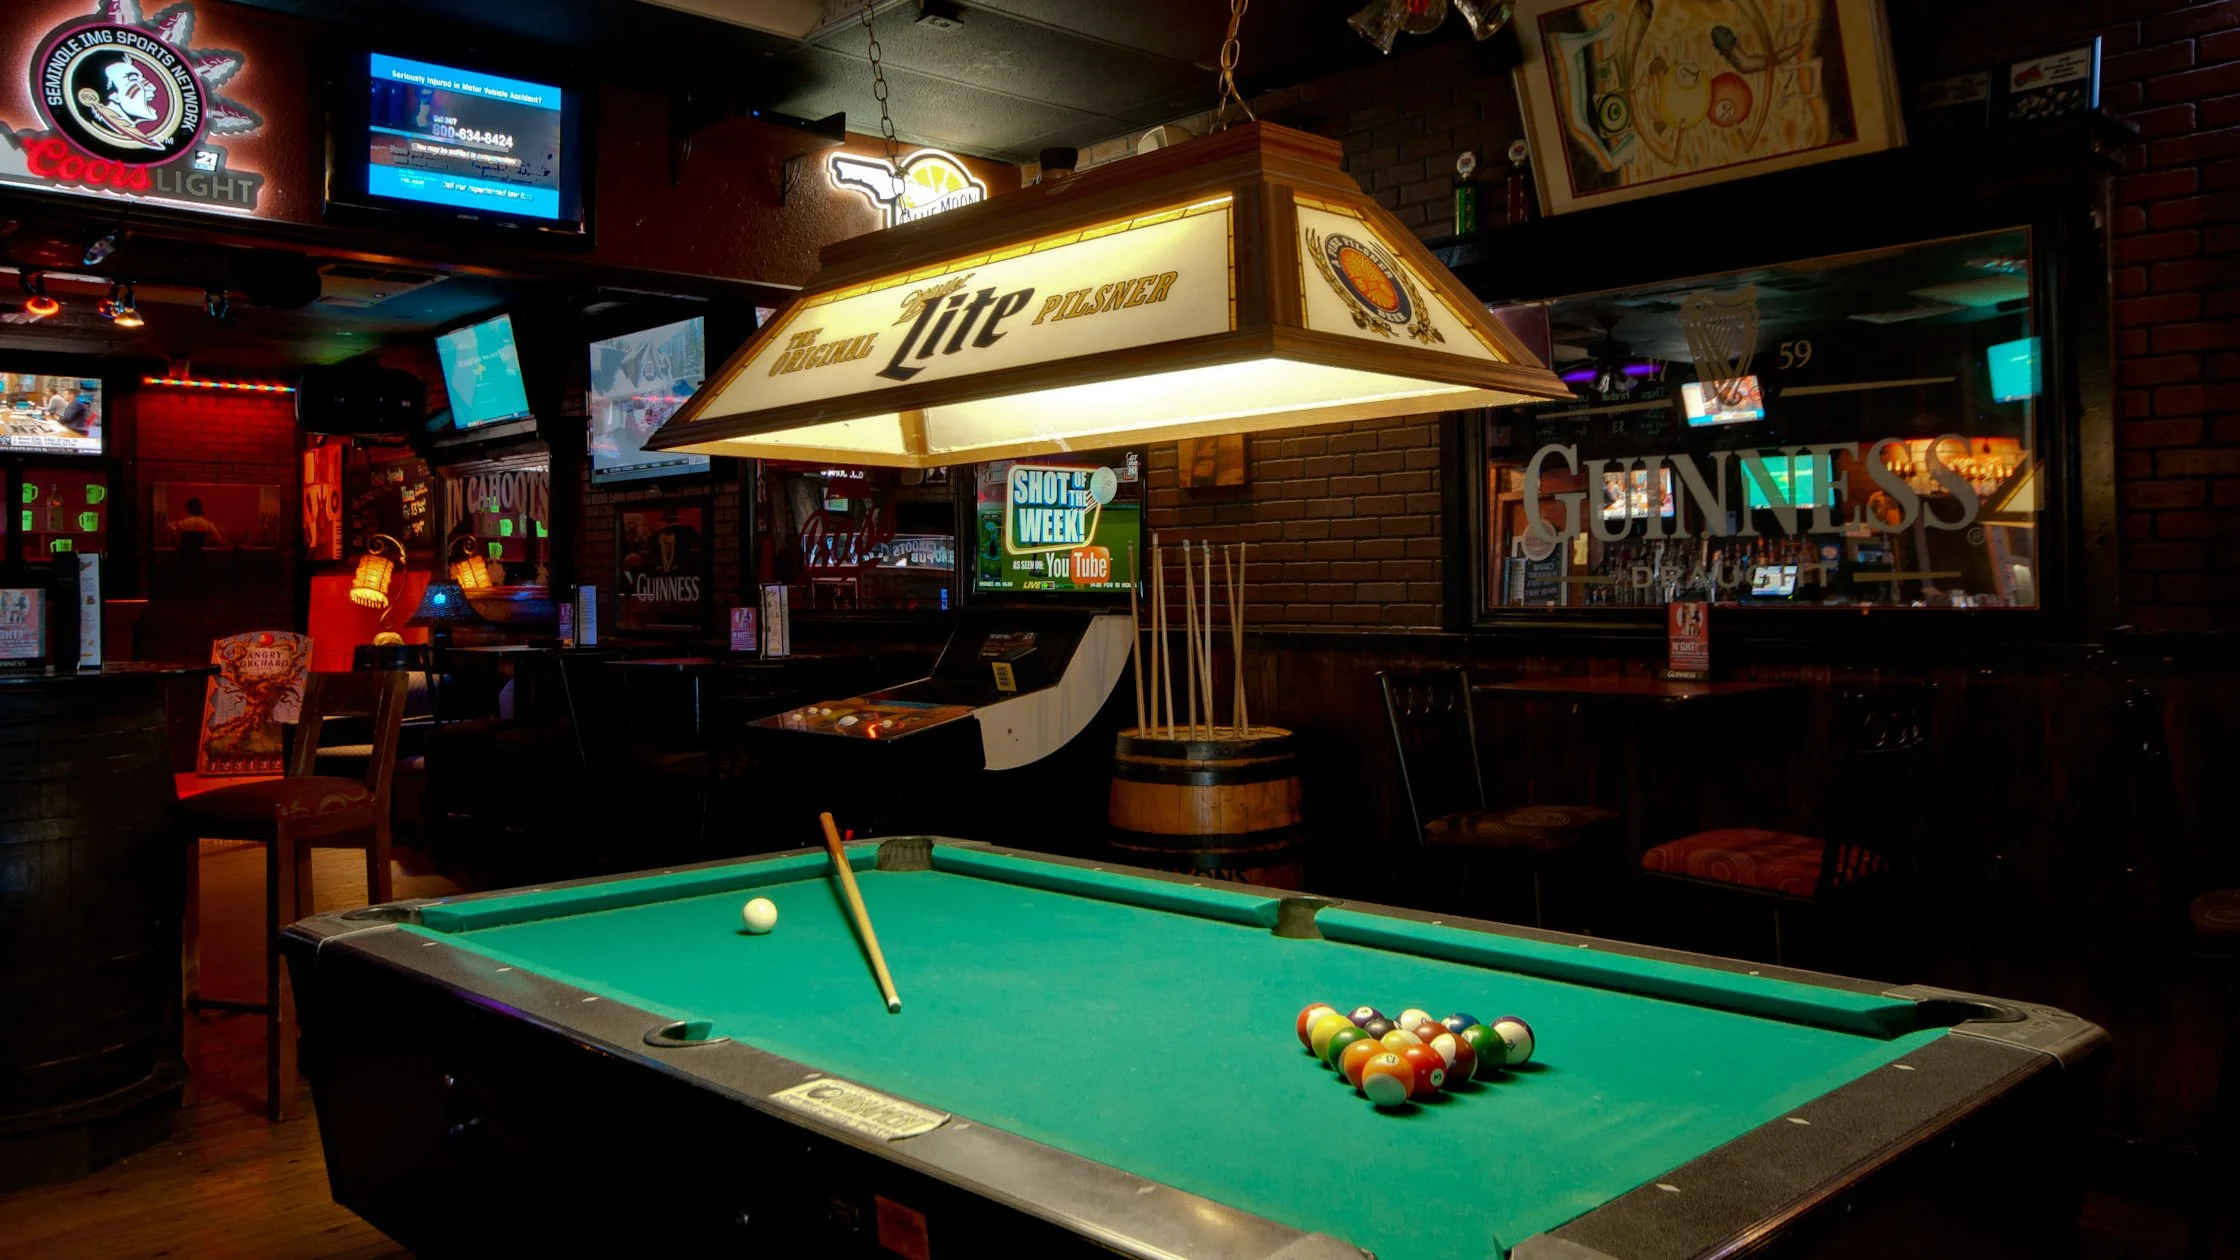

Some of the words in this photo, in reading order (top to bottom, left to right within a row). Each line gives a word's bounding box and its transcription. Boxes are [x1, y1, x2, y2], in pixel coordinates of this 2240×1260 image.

[44, 38, 82, 107] SEMINOLE
[77, 30, 113, 48] IMG
[116, 30, 174, 67] SPORTS
[171, 66, 200, 134] NETWORK
[392, 70, 425, 84] Seriously
[427, 76, 452, 88] Injured
[462, 83, 482, 93] Motor
[484, 87, 508, 98] Vehicle
[510, 92, 542, 104] Accident?
[432, 123, 514, 149] 800-634-8424
[21, 137, 150, 191] Coors
[156, 168, 254, 203] LIGHT
[941, 193, 977, 212] MOON
[1032, 271, 1179, 325] PILSNER
[785, 328, 824, 351] THE
[875, 287, 1035, 381] Lite
[768, 332, 879, 377] ORIGINAL
[1779, 340, 1813, 369] 59
[447, 478, 463, 536] IN
[467, 472, 549, 530] CAHOOTS
[1014, 470, 1071, 505] SHOT
[1073, 472, 1087, 488] OF
[1069, 490, 1088, 507] THE
[1522, 433, 1982, 544] GUINNESS
[1019, 507, 1086, 544] WEEK!
[636, 572, 700, 602] GUINNESS
[1023, 581, 1041, 590] LIVE
[1631, 561, 1838, 590] DRAUGHT
[240, 659, 289, 667] ORCHARD
[247, 651, 281, 659] ANGRY
